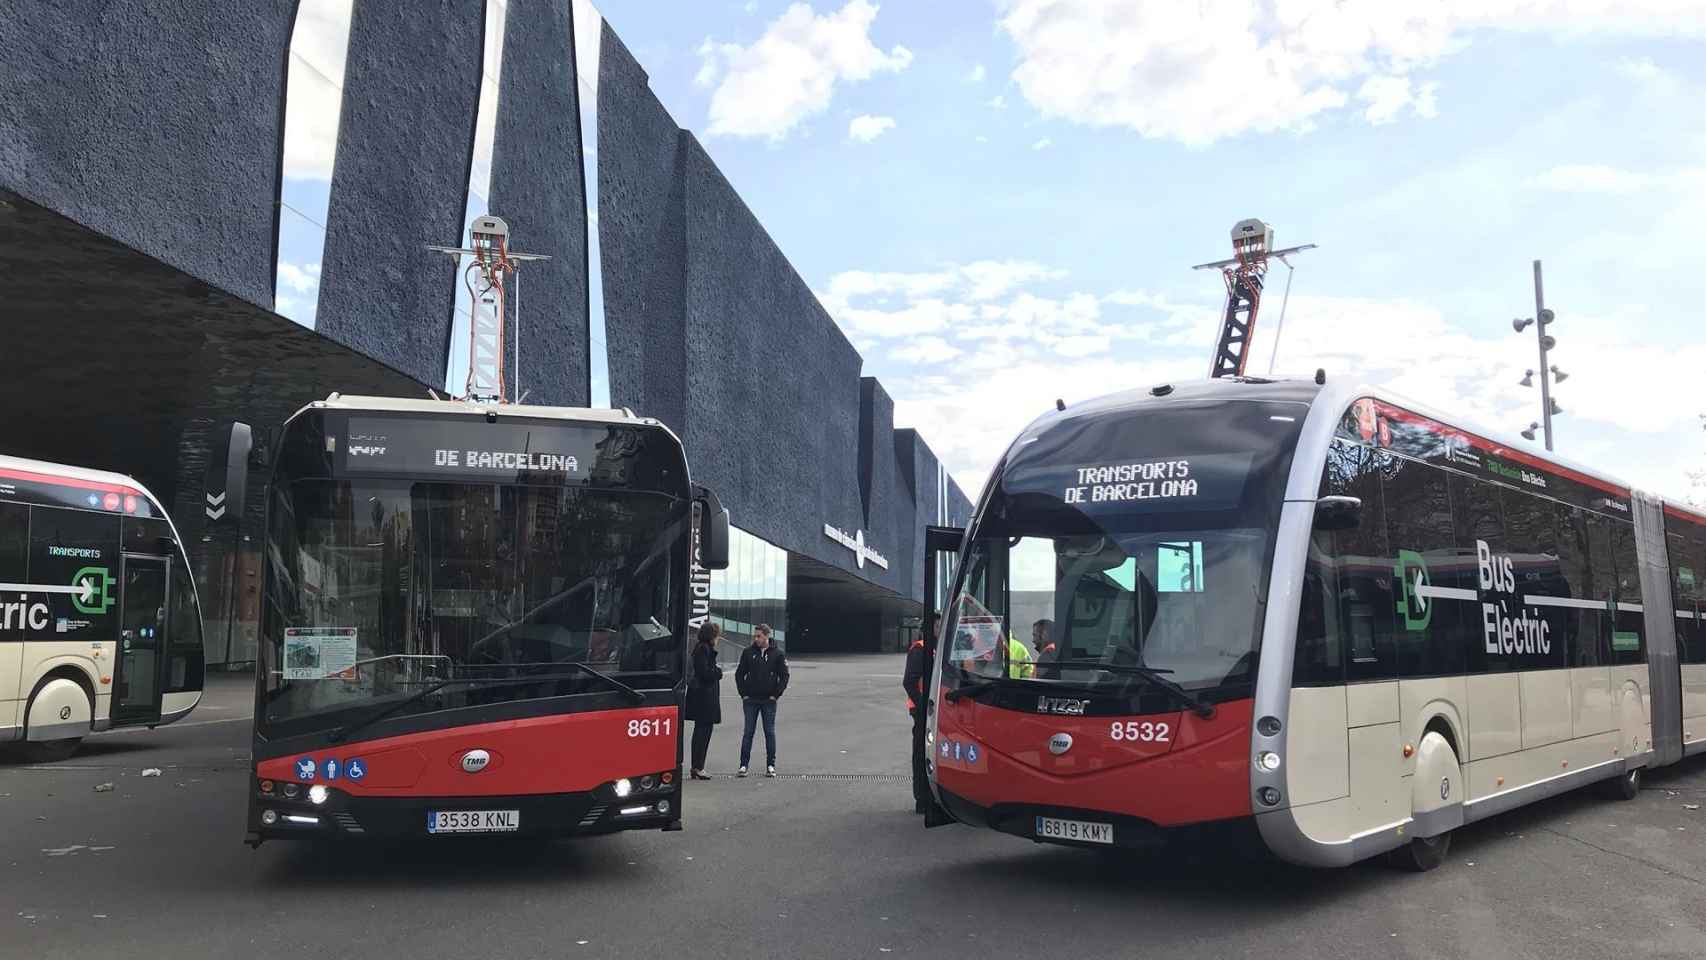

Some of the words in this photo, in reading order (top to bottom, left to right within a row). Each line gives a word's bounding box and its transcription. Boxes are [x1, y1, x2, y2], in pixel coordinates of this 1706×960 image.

[435, 450, 459, 467] DE
[466, 451, 578, 472] BARCELONA
[1077, 460, 1189, 485] TRANSPORTS
[1064, 486, 1089, 504] DE
[1091, 479, 1198, 503] BARCELONA
[48, 546, 101, 559] TRANSPORTS
[1476, 539, 1516, 594] Bus
[1482, 599, 1551, 655] Elèctric
[627, 718, 671, 737] 8611
[1110, 721, 1169, 742] 8532
[466, 758, 486, 766] TMB
[439, 813, 480, 828] 3538
[485, 812, 515, 827] KNL
[1045, 820, 1078, 838] 6819
[1081, 824, 1109, 841] KMY
